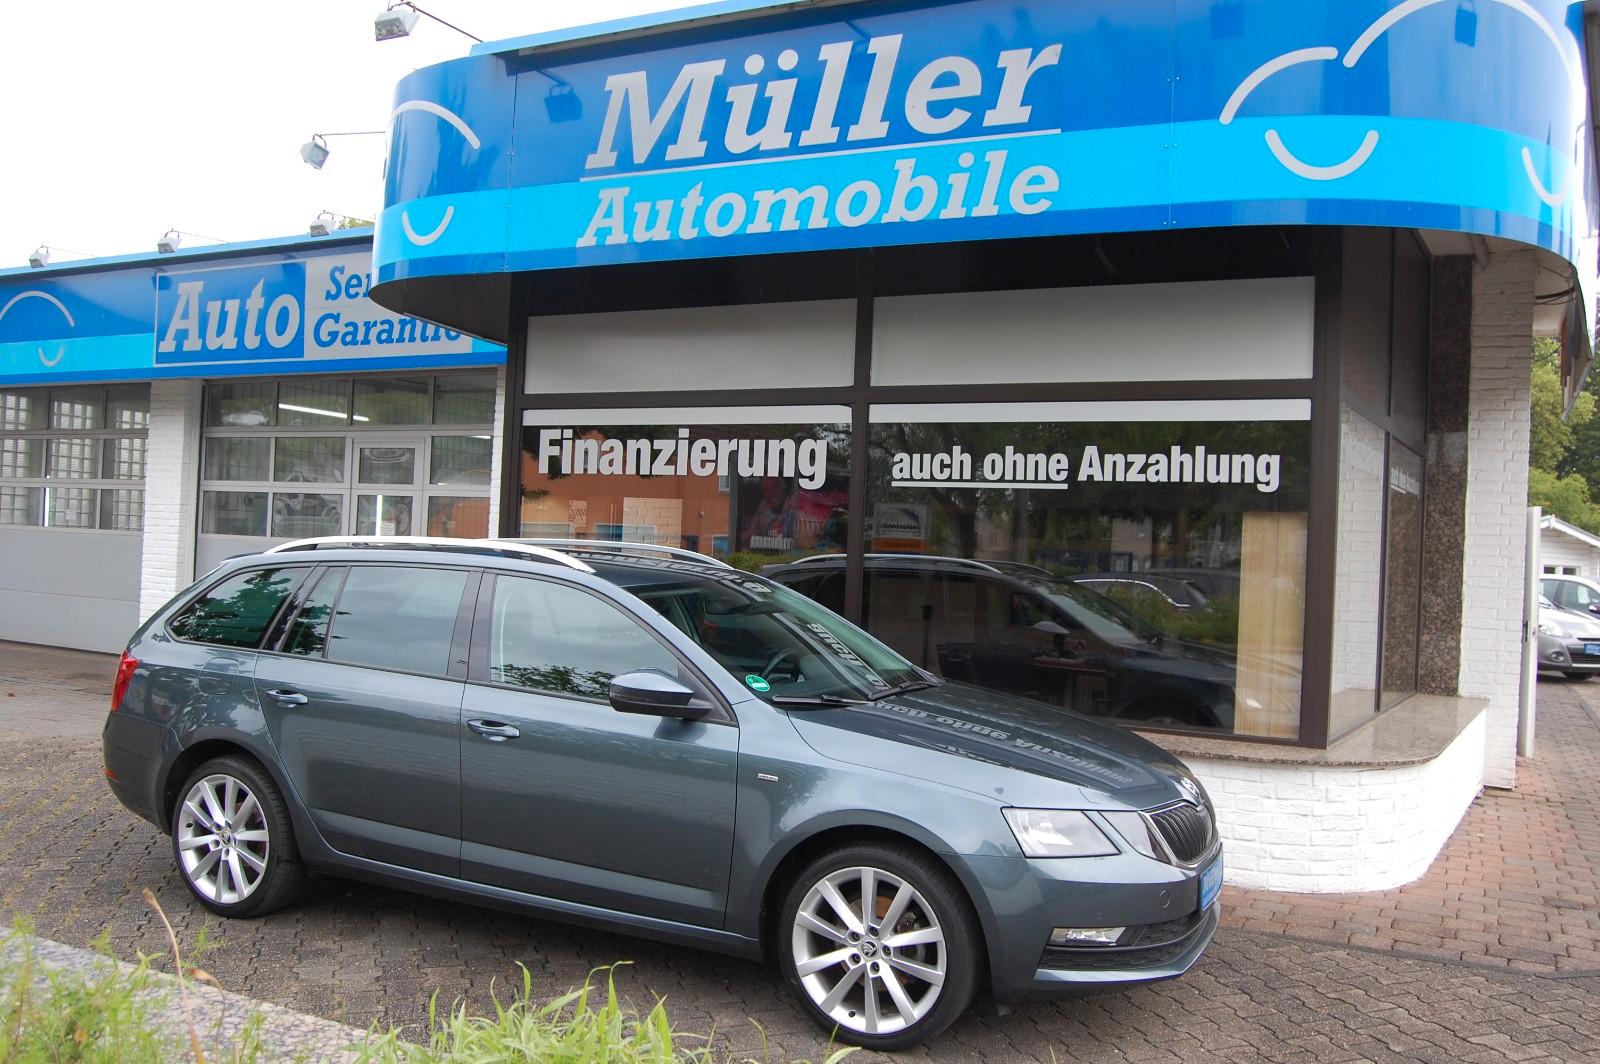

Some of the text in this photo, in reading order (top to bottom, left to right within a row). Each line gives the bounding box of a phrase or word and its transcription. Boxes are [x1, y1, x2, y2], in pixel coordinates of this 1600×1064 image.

[584, 33, 1063, 170] Müller
[576, 150, 1061, 248] Automobile
[159, 277, 301, 353] Auto
[537, 428, 829, 490] Finanzierung
[892, 445, 1281, 493] auch ohne Anzahlung
